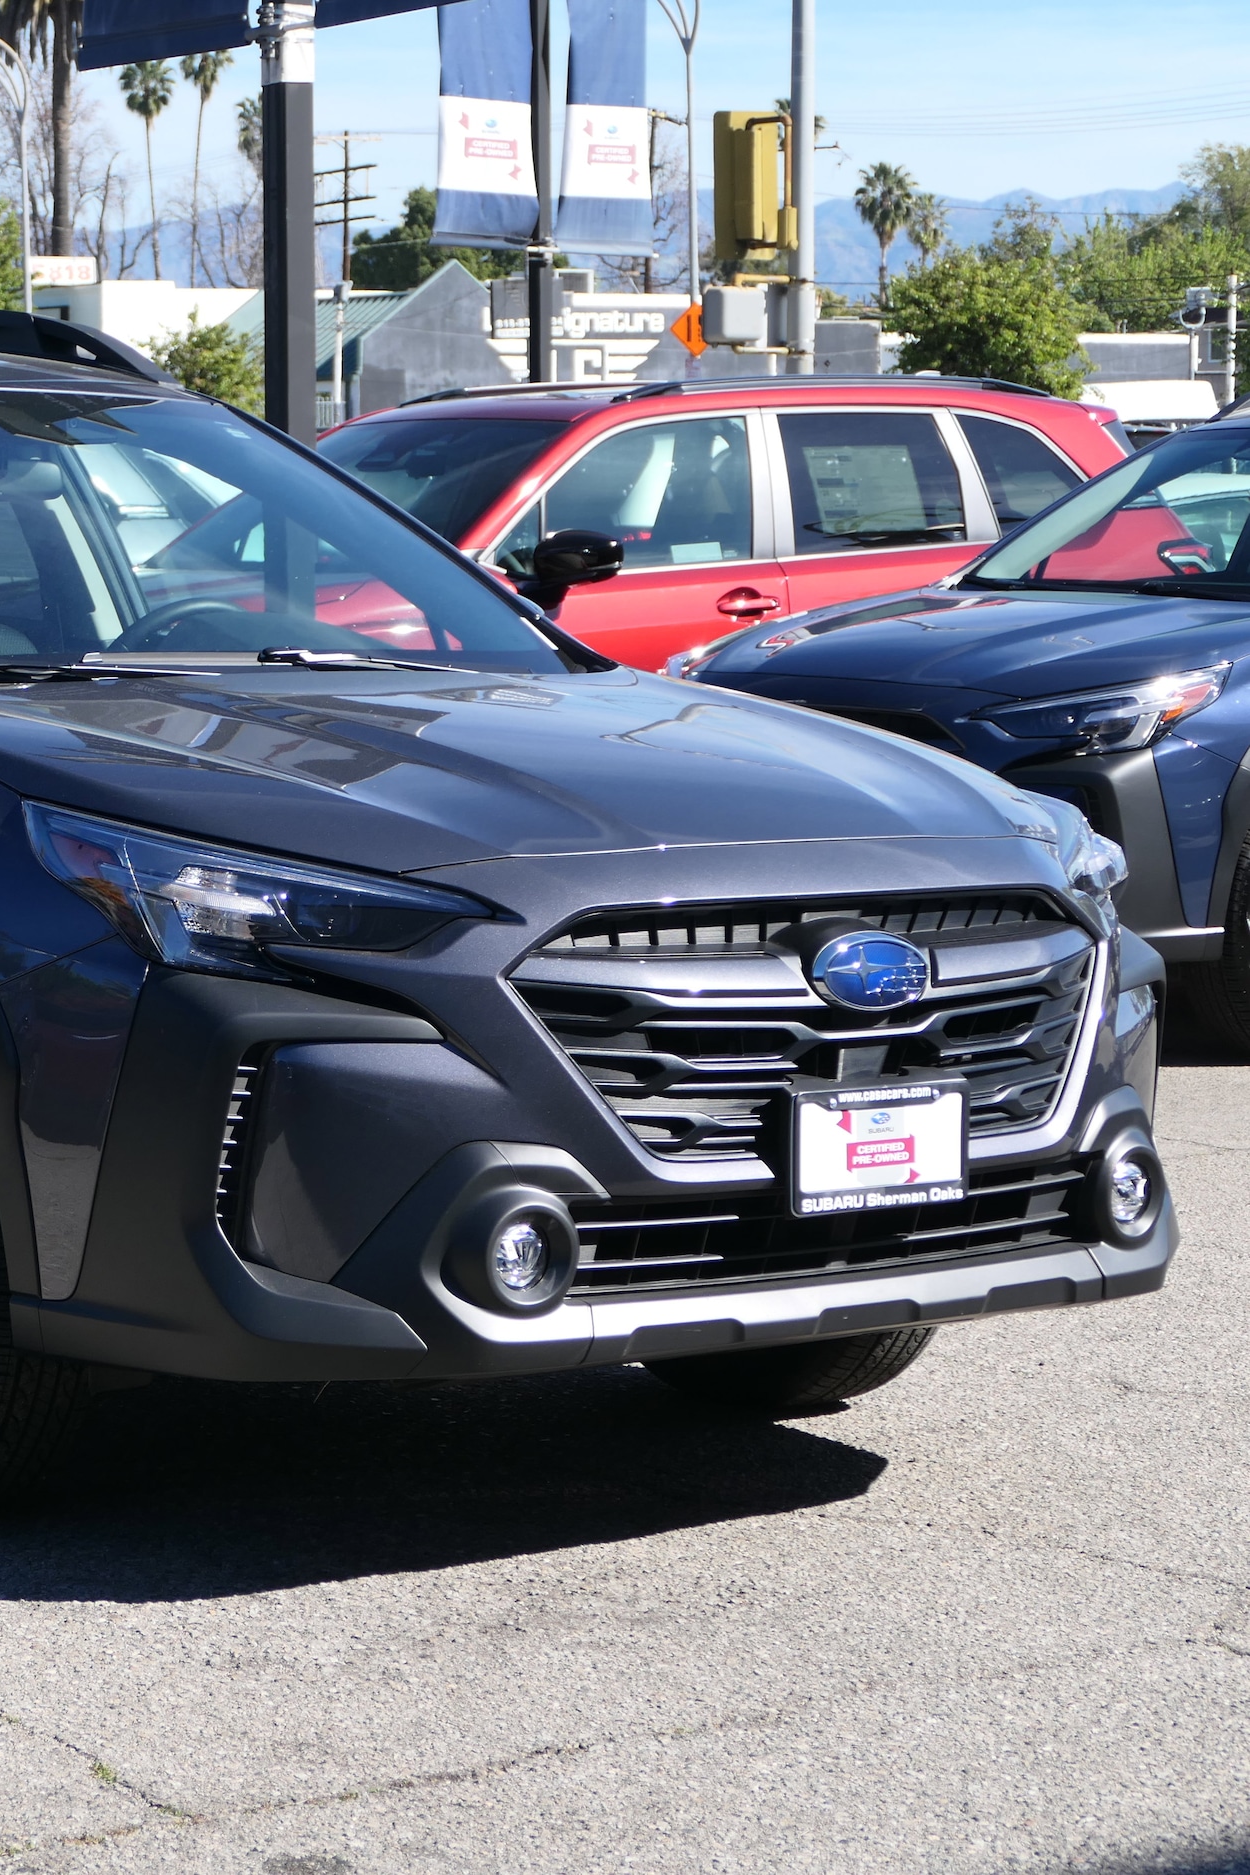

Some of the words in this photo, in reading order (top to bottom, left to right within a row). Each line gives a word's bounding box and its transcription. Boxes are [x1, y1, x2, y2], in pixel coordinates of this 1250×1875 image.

[562, 306, 665, 339] ignature
[838, 1086, 932, 1103] www.casacars.com
[868, 1127, 895, 1135] SUBARU
[856, 1142, 906, 1155] CERTIFIED
[852, 1151, 910, 1165] PRE-OWNED
[801, 1194, 865, 1213] SUBARU
[866, 1191, 928, 1207] Sherman
[929, 1186, 964, 1202] Oaks
